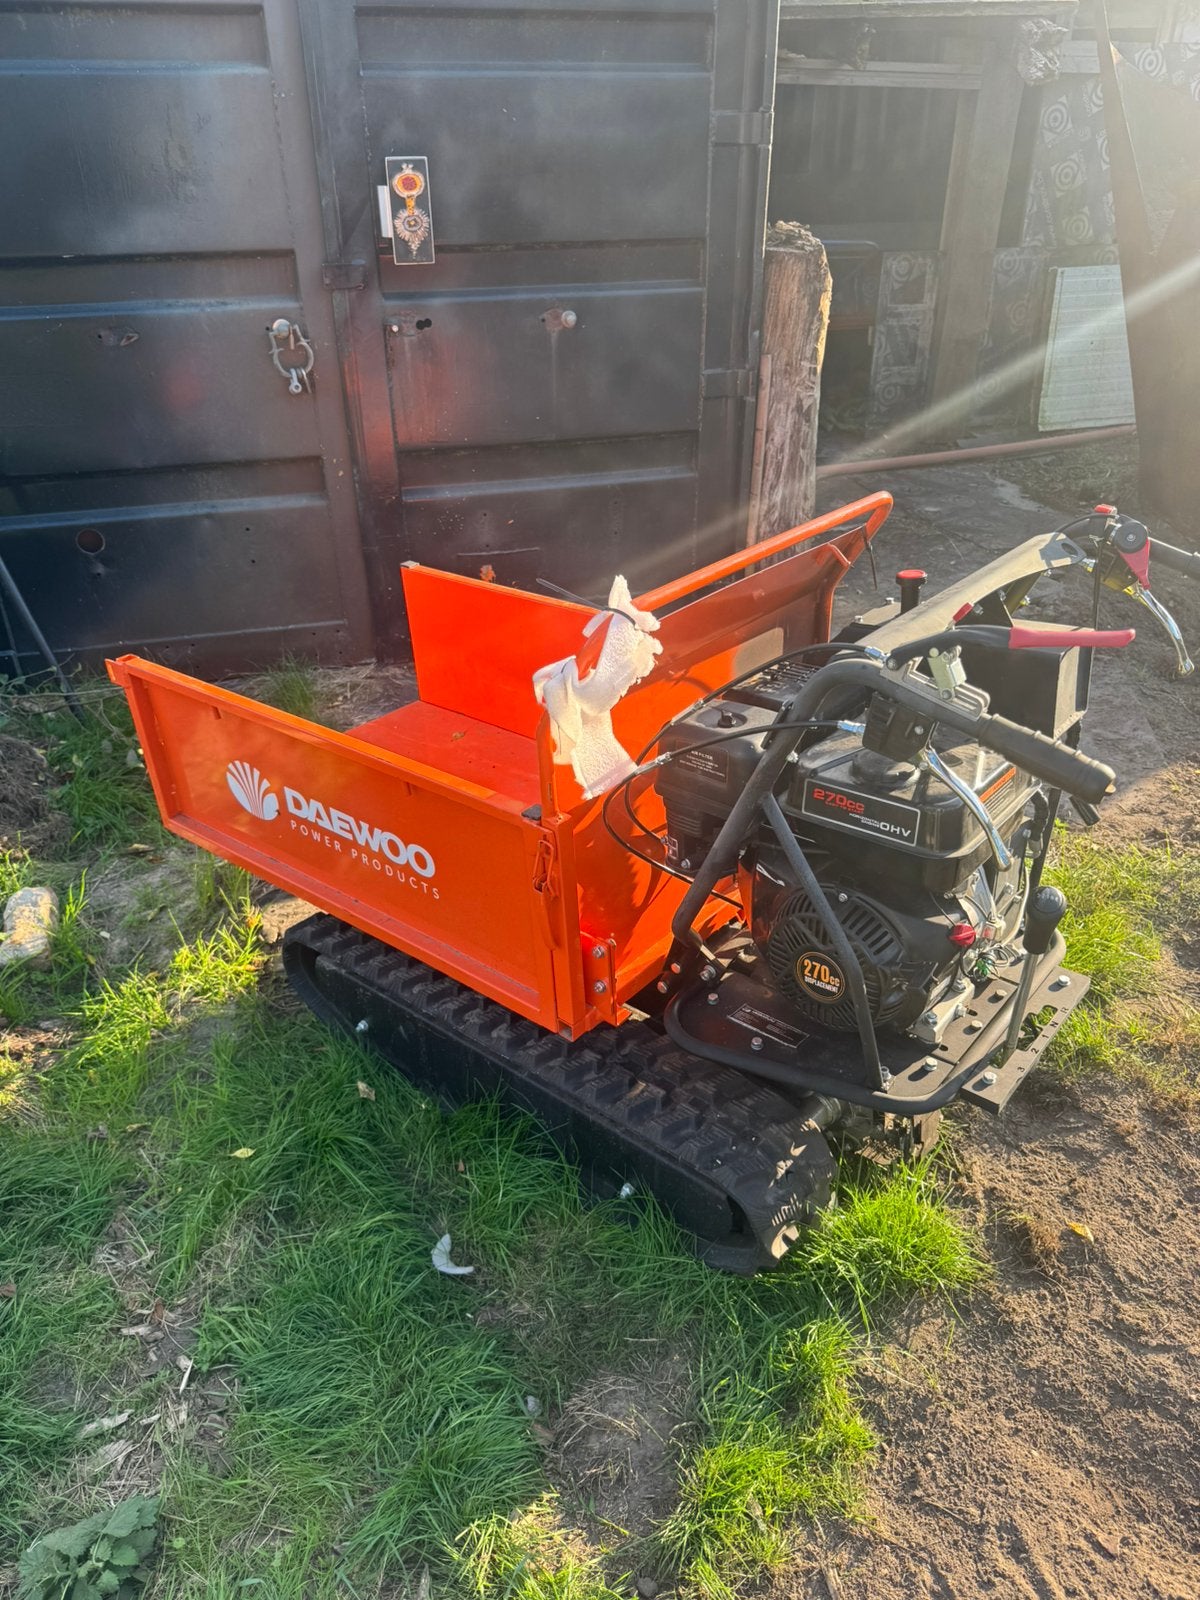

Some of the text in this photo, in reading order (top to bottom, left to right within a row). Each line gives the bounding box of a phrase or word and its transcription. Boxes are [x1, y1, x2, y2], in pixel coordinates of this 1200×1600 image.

[813, 788, 865, 812] 270cc
[284, 786, 436, 879] DAEWOO
[879, 821, 911, 837] OHV
[290, 819, 440, 900] POWER PRODUCTS
[803, 959, 840, 986] 270cc
